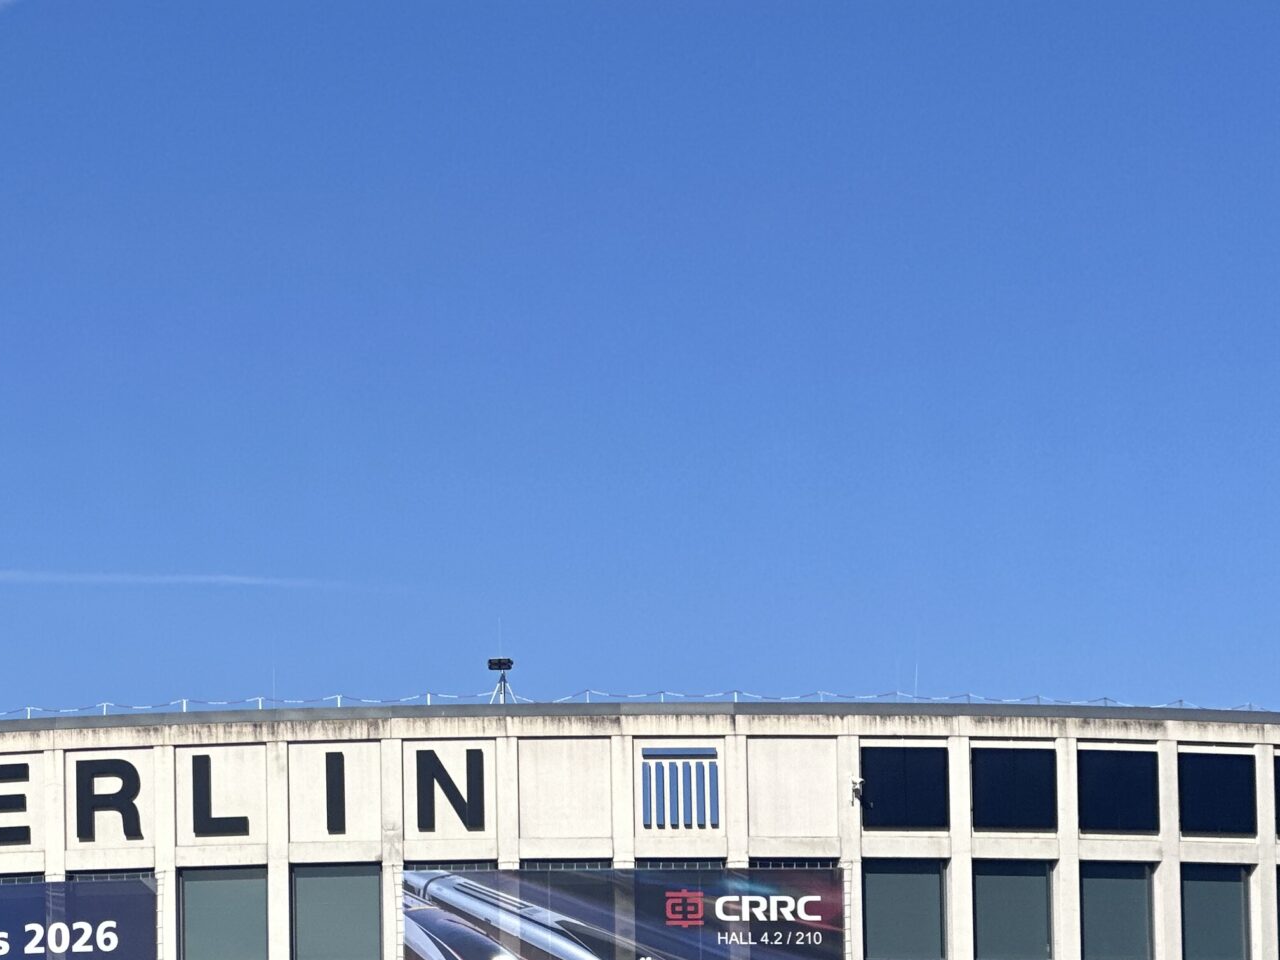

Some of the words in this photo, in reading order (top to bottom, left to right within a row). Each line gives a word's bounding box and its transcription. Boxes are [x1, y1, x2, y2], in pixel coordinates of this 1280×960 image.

[715, 895, 822, 921] CRRC
[23, 920, 119, 954] 2026
[717, 931, 756, 945] HALL
[760, 931, 783, 945] 4.2
[796, 931, 822, 944] 210
